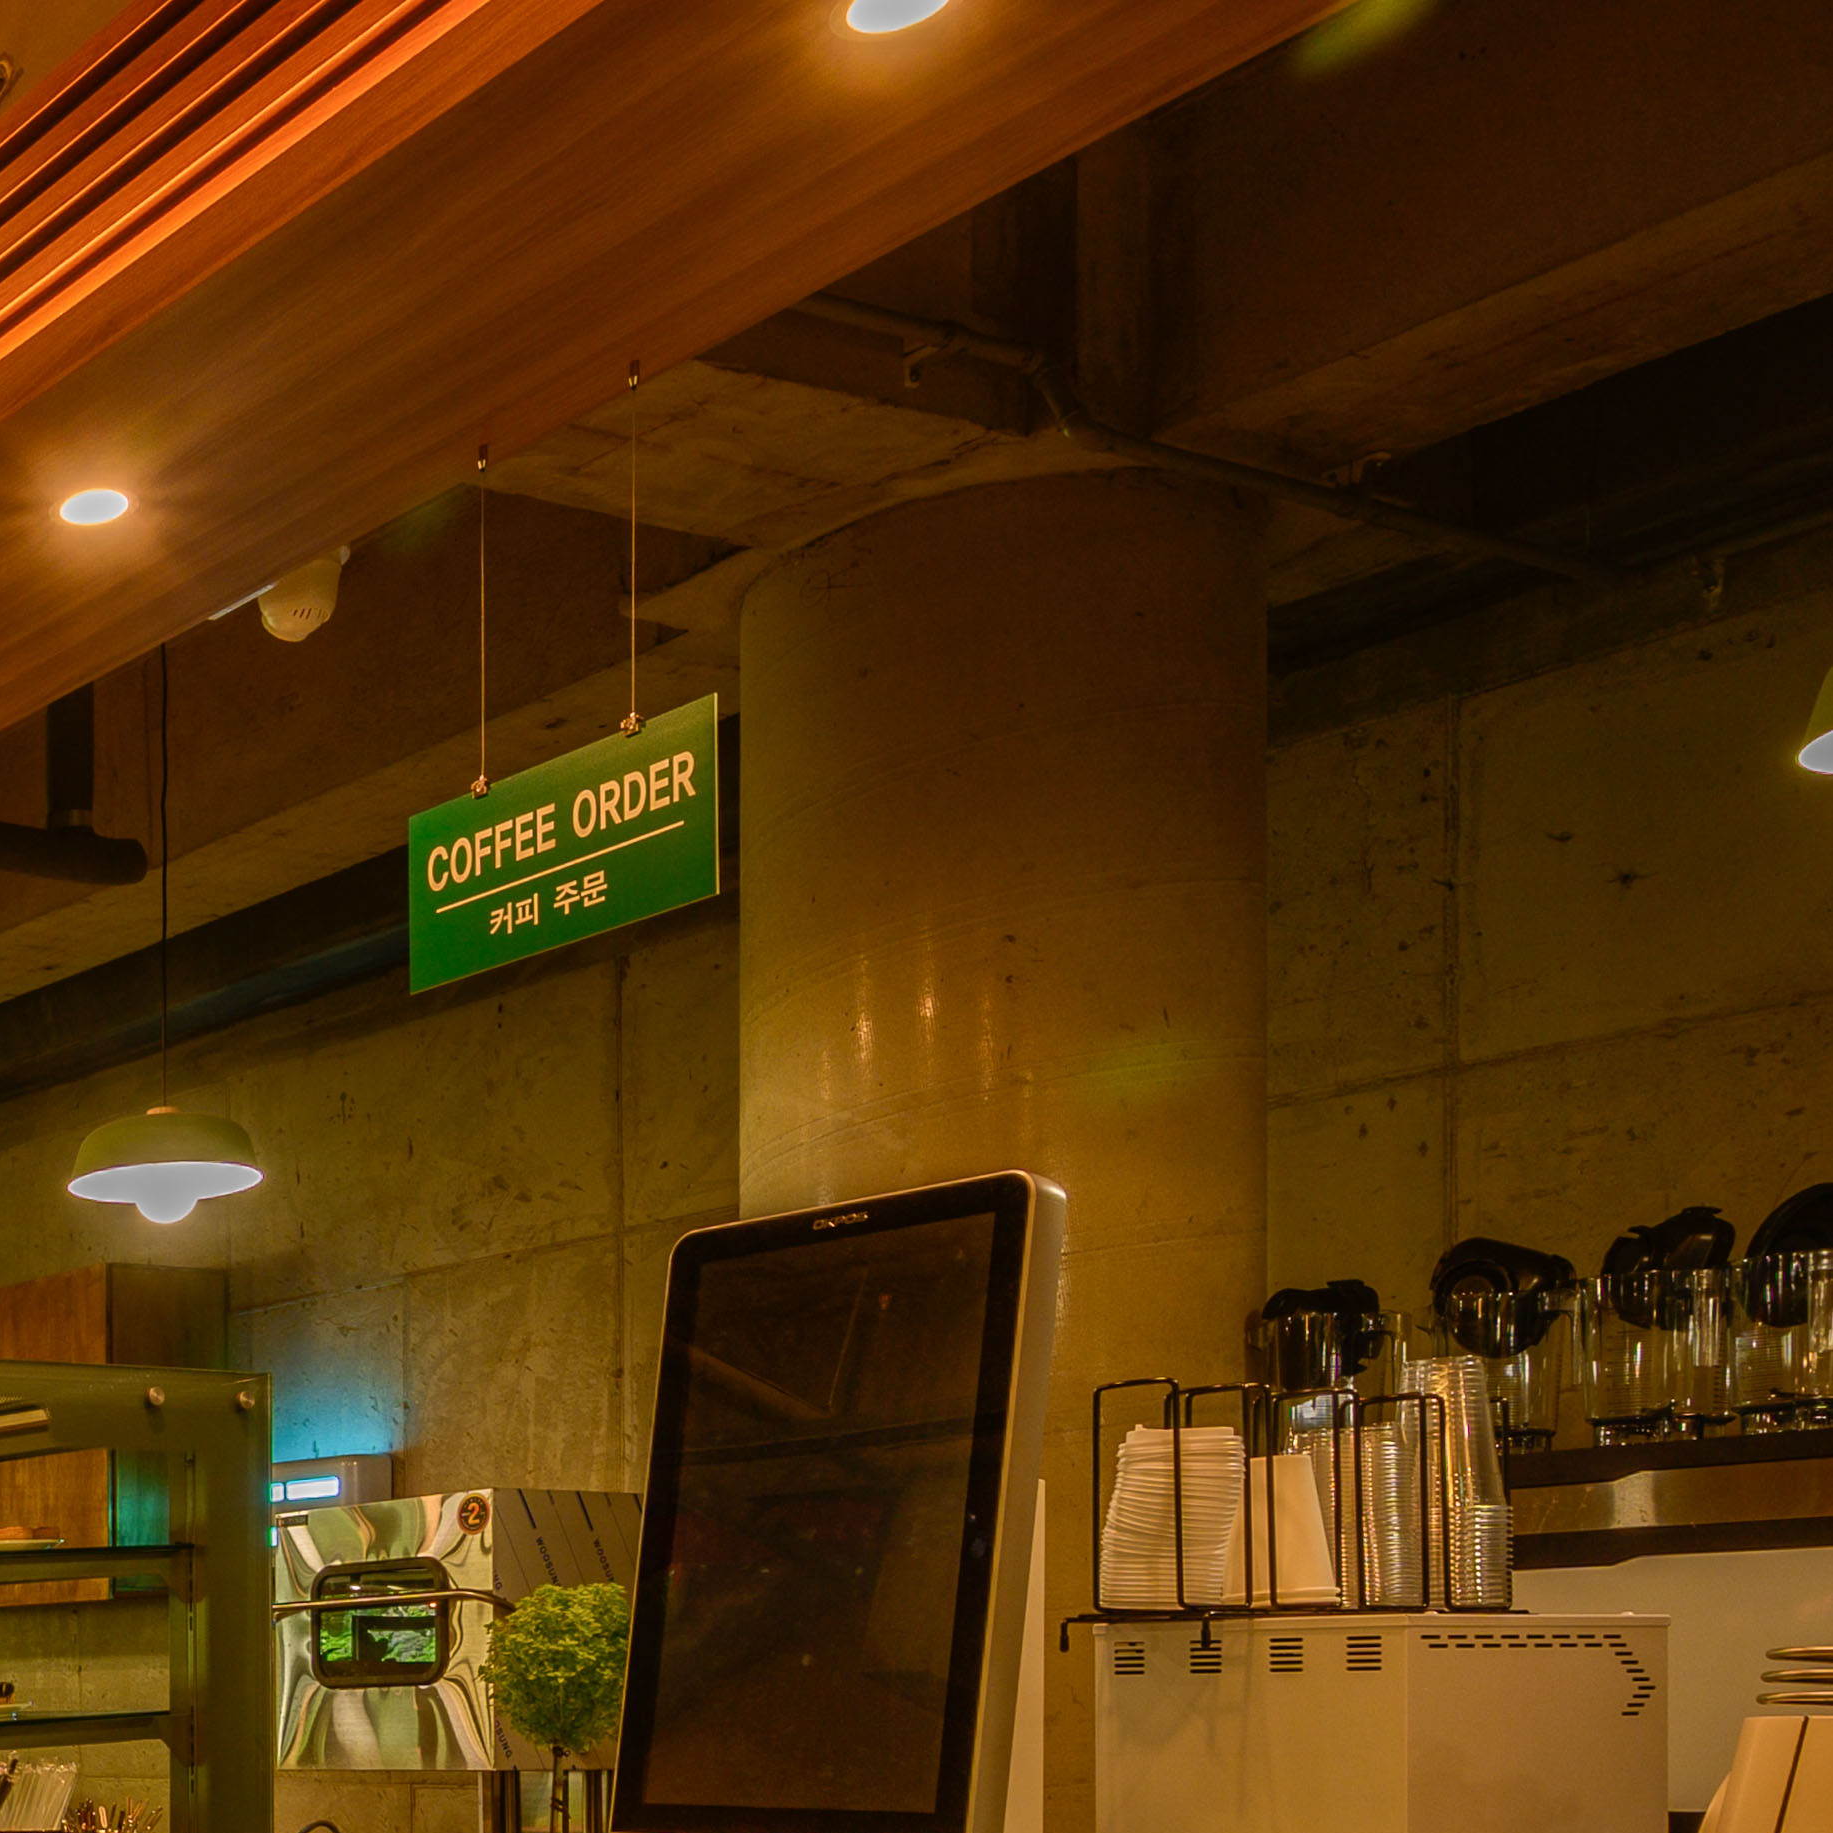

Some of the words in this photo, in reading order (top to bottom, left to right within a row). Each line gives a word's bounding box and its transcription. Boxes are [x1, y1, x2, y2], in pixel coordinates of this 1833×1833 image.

[427, 803, 557, 892] COFFEE
[572, 751, 696, 839] ORDER
[490, 894, 539, 935] 커피
[553, 870, 608, 915] 주문
[467, 1502, 480, 1525] 2
